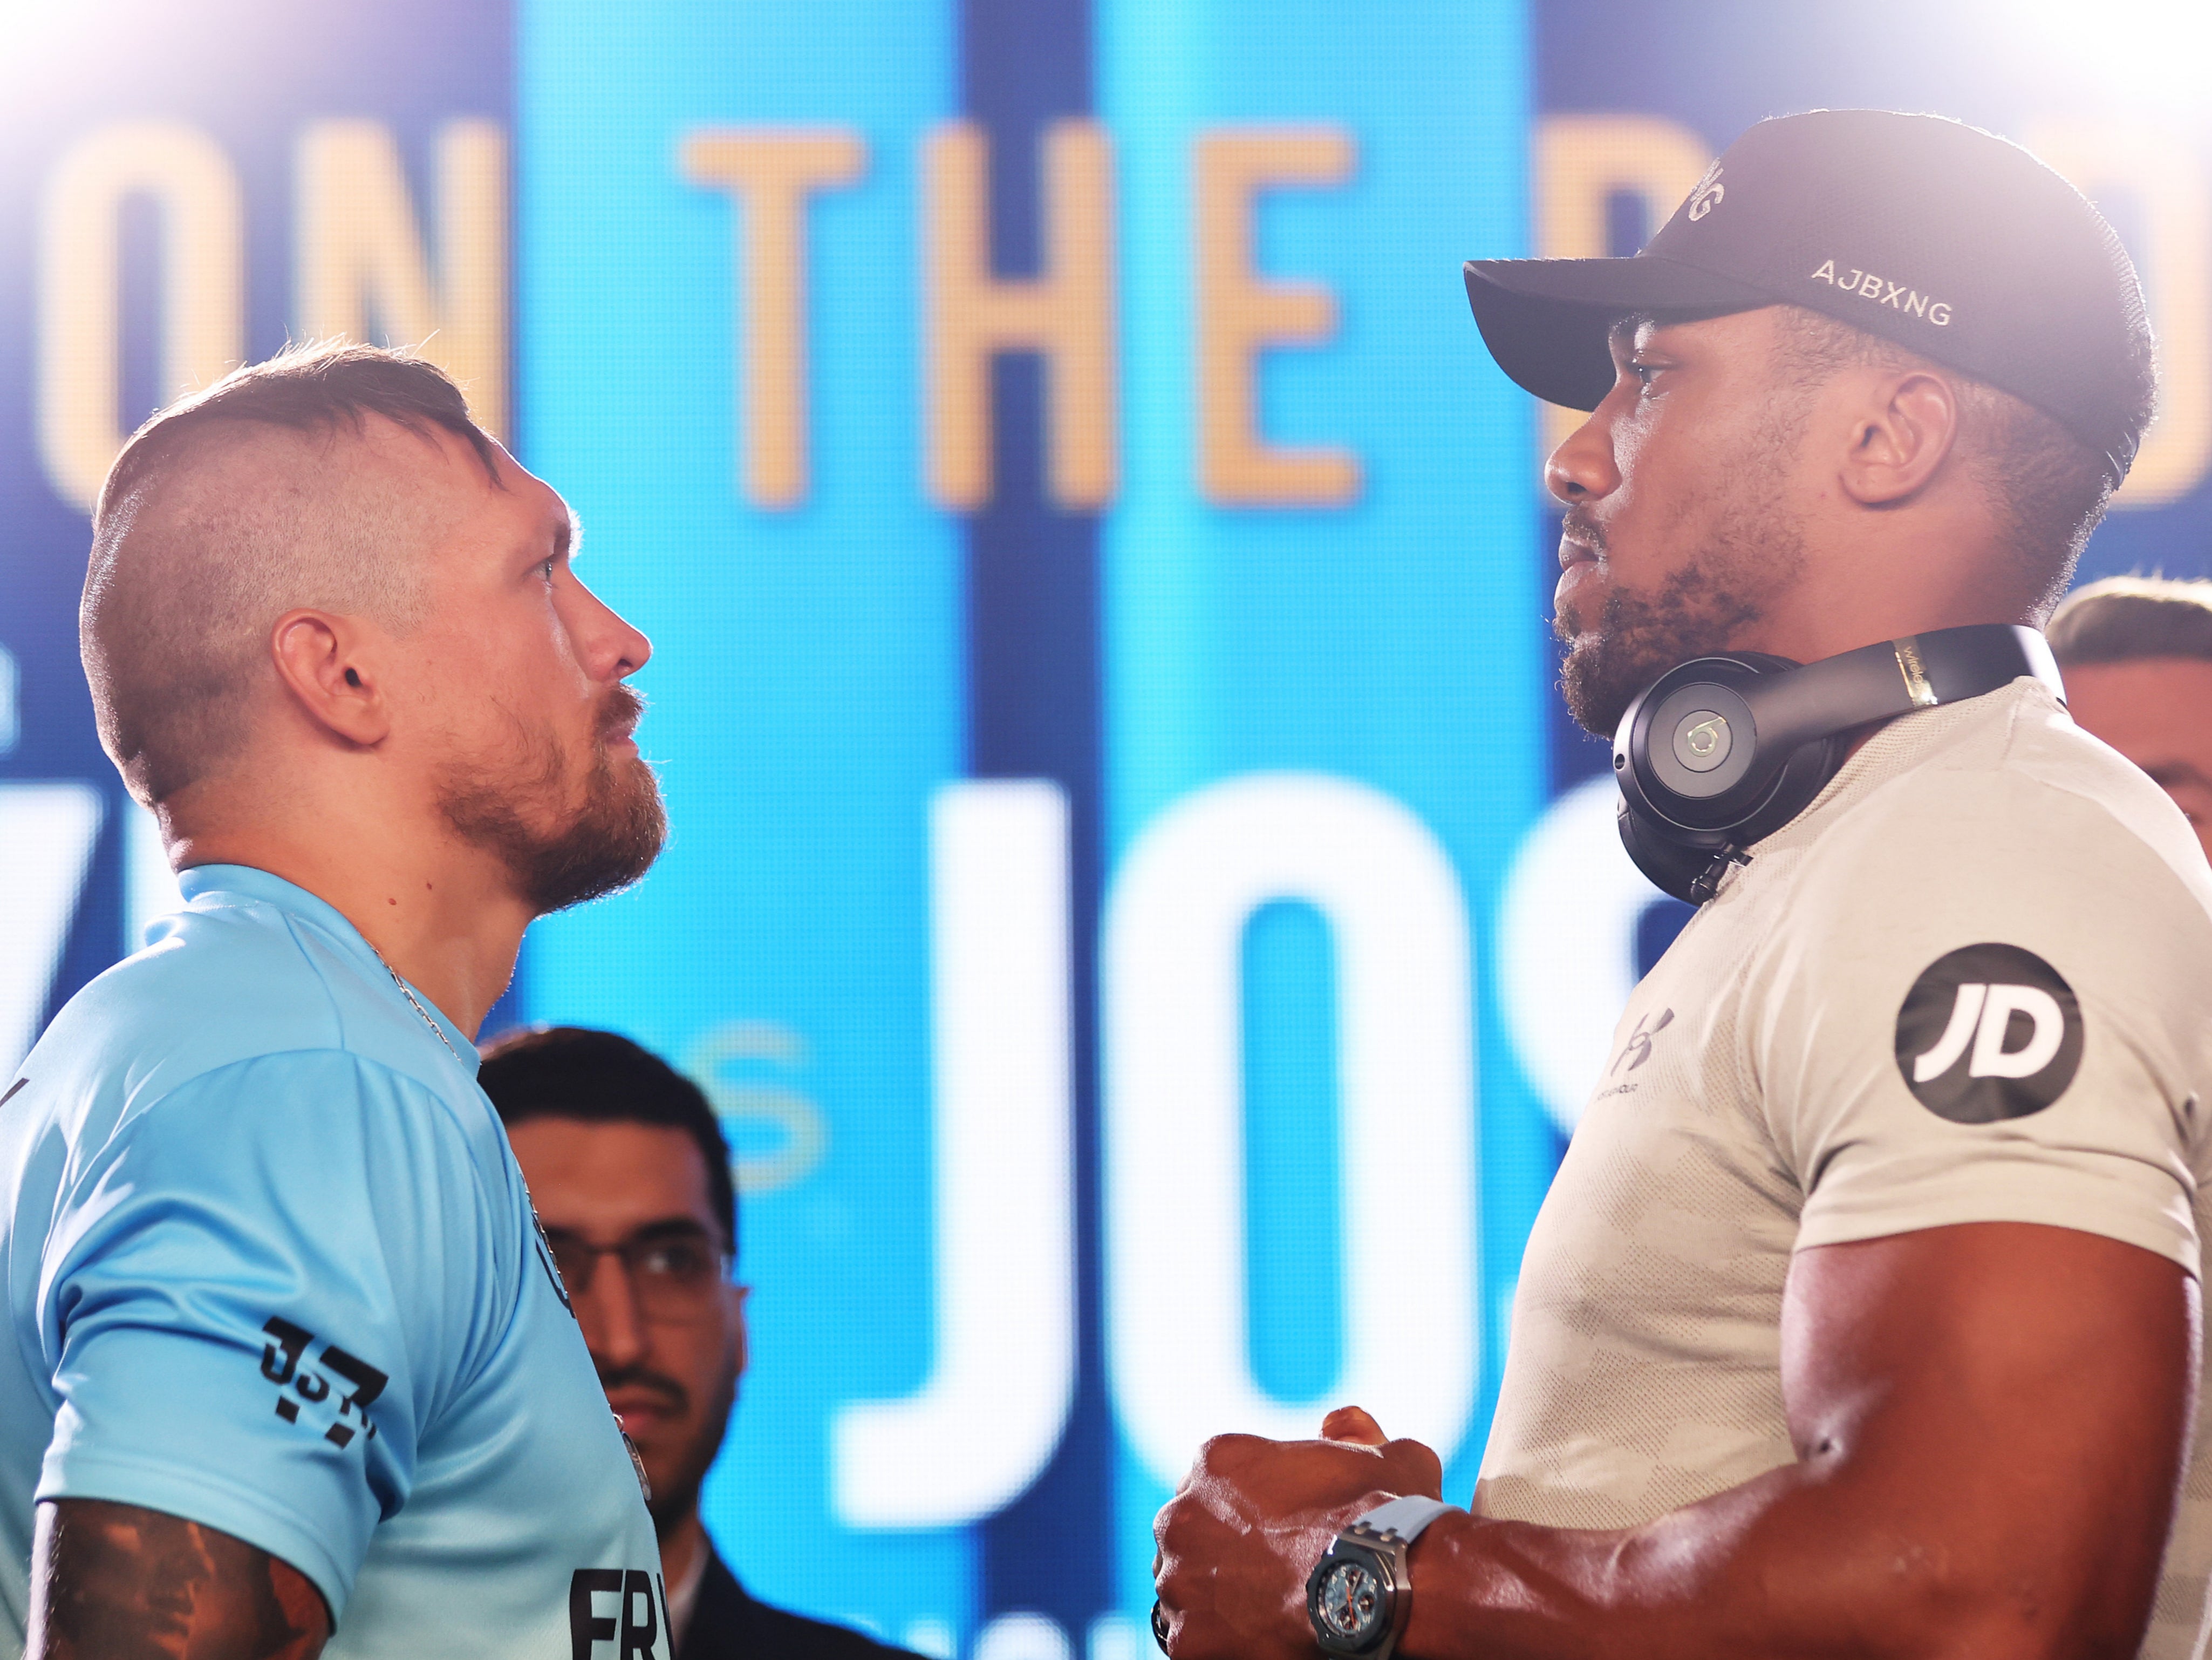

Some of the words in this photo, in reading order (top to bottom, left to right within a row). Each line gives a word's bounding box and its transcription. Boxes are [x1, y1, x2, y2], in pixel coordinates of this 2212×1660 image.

[37, 116, 513, 513] ON
[677, 121, 1362, 510] THE
[1812, 260, 1952, 326] AJBXNG
[1913, 983, 2065, 1082] JD
[570, 1568, 675, 1660] FR
